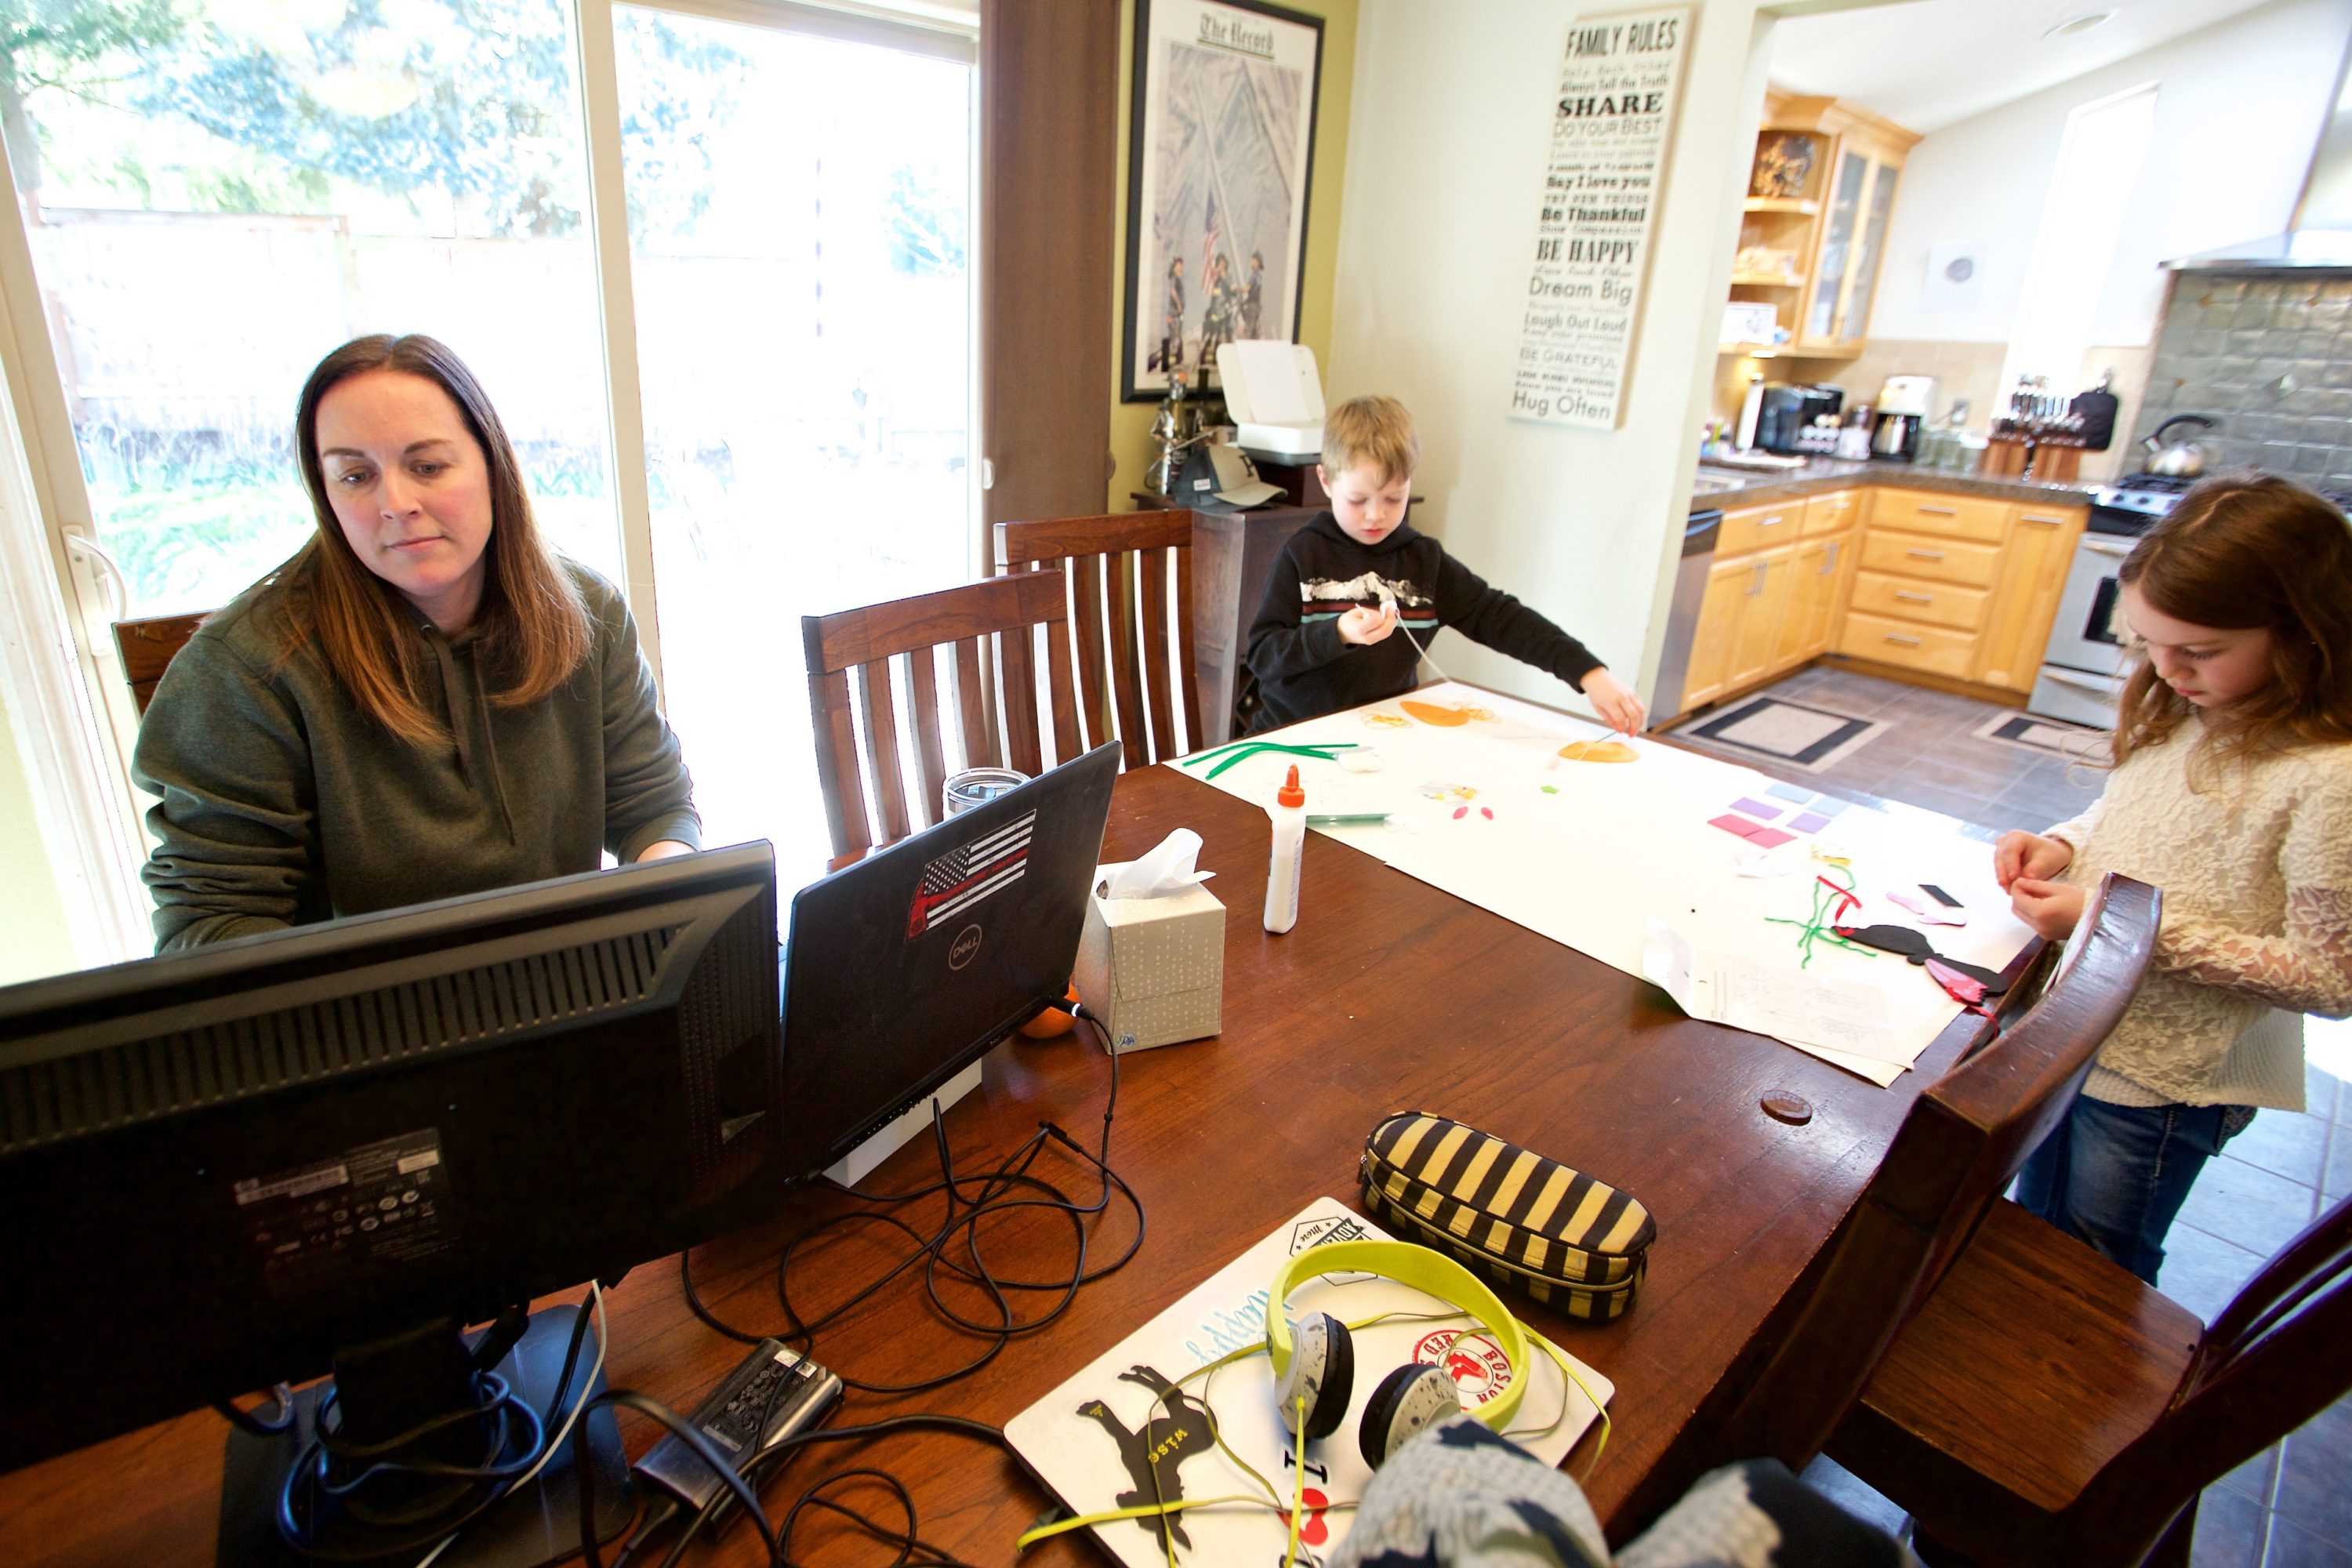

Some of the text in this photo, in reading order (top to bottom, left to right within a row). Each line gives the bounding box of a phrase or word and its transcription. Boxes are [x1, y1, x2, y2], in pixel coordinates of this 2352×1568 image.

[1200, 12, 1227, 41] The
[1230, 20, 1273, 51] Record
[1566, 20, 1678, 60] FAMILY RULES
[1559, 94, 1663, 118] SHARE
[1548, 174, 1651, 192] Say I love you
[1542, 207, 1646, 223] Be Thankful
[1537, 238, 1639, 264] BE HAPPY
[1529, 276, 1633, 307] Dream Big
[1525, 312, 1628, 334] Laugh Out Loud
[1512, 390, 1612, 421] Hug Often
[953, 935, 978, 960] DELL
